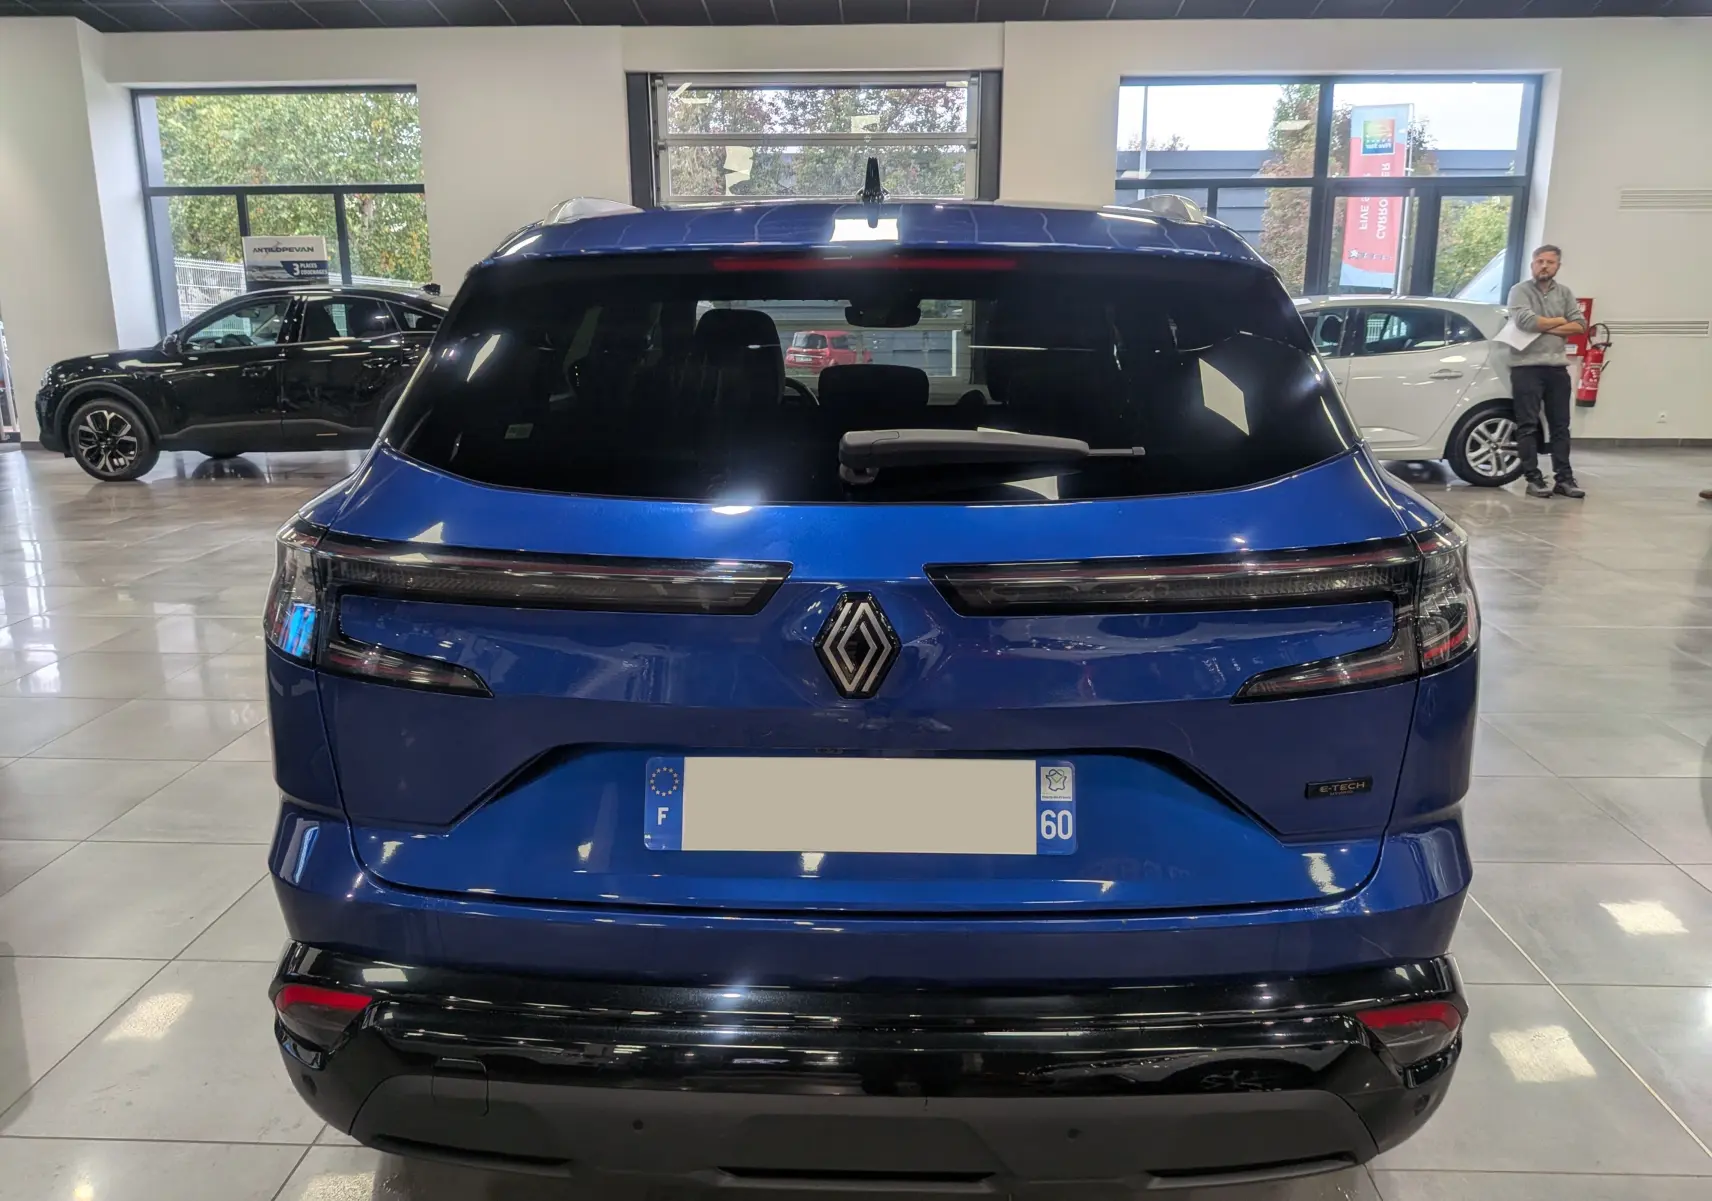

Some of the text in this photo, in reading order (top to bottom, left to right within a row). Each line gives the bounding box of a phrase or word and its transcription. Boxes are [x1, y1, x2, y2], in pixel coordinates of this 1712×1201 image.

[293, 263, 300, 276] 3
[1320, 781, 1365, 793] E-TECH
[658, 807, 669, 825] F
[1041, 809, 1073, 840] 60
